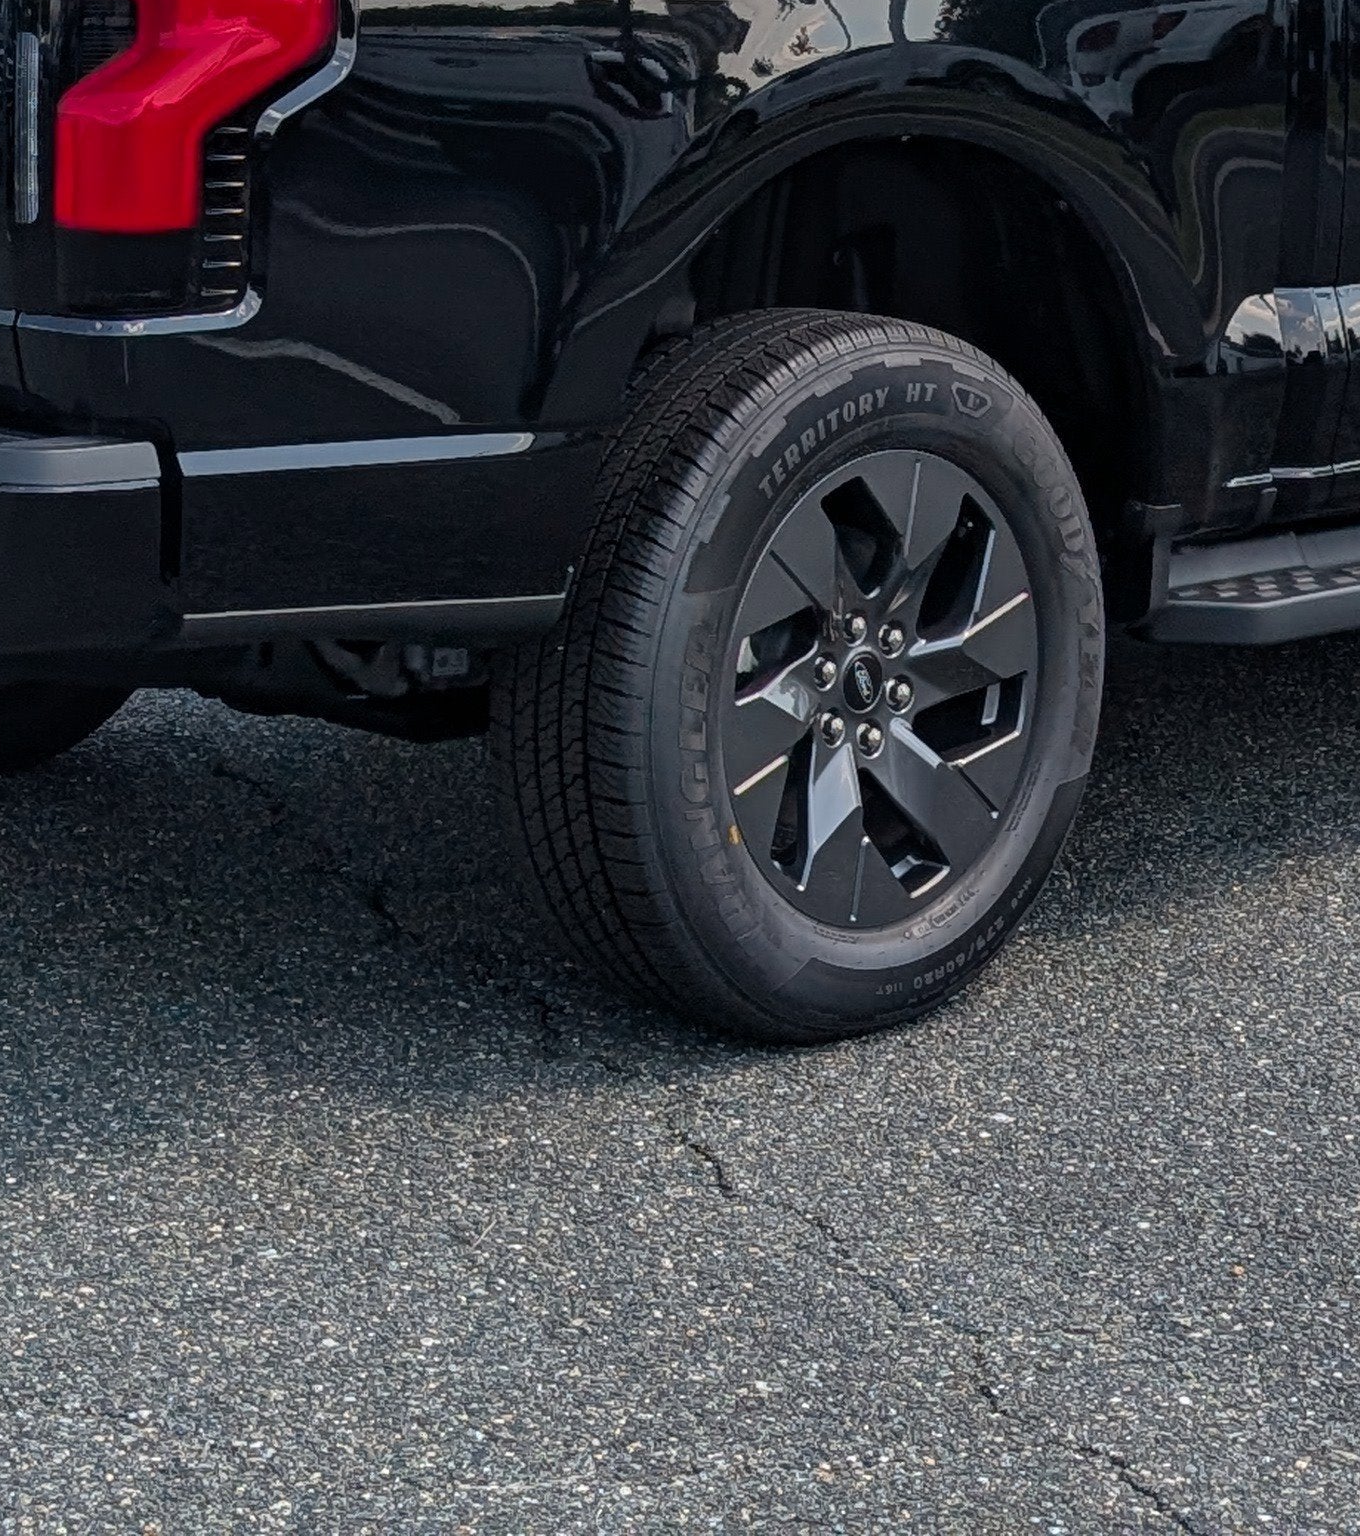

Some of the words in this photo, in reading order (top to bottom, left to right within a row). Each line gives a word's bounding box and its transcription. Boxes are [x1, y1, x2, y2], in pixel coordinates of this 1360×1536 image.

[757, 386, 890, 500] TERRITORY
[905, 382, 938, 403] HT
[1012, 424, 1101, 756] GOODYE
[676, 612, 778, 959] RANGLER
